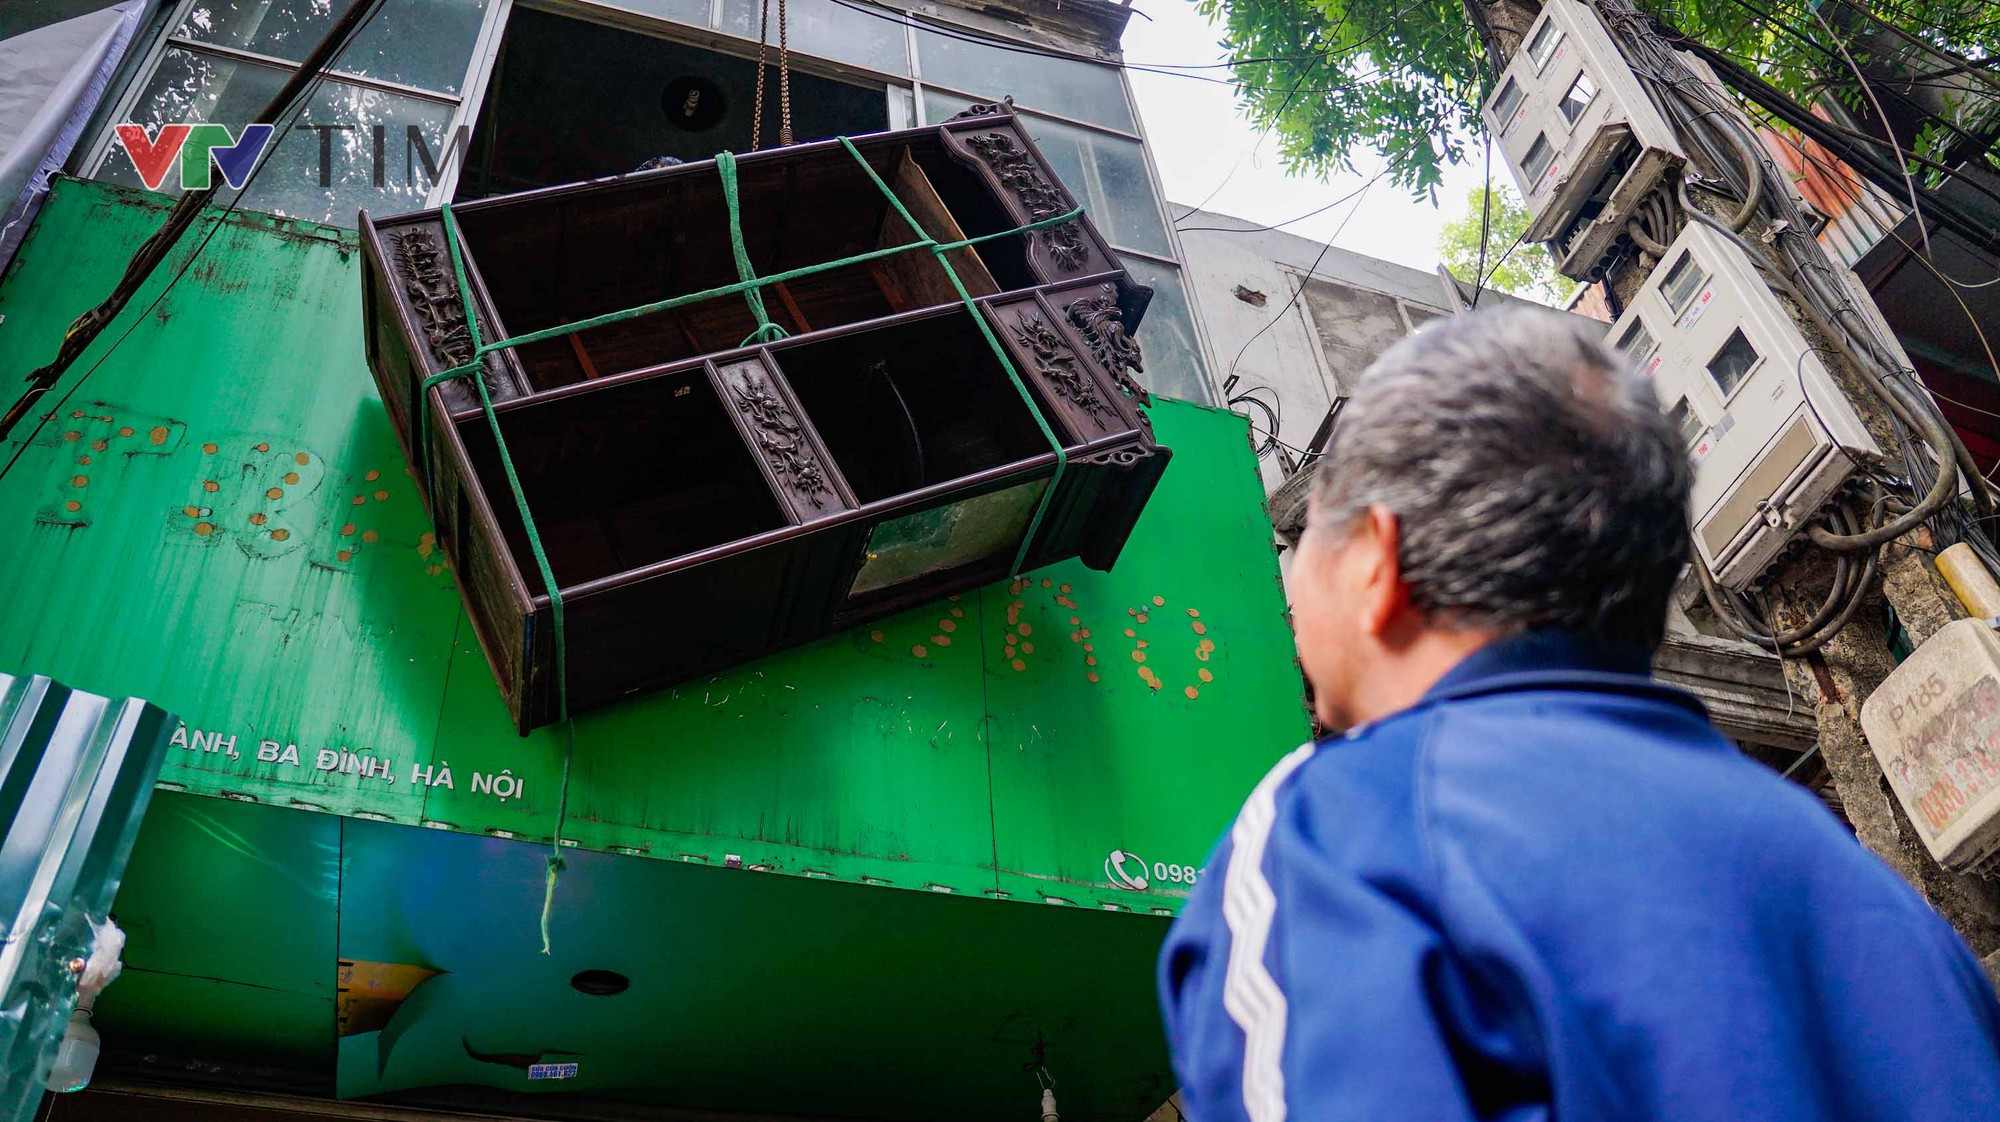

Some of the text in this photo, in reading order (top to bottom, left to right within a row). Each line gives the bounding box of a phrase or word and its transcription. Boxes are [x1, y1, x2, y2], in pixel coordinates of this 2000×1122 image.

[1889, 672, 1946, 731] P185
[257, 740, 300, 766] BA
[316, 746, 395, 785] ĐÌNH,
[411, 760, 455, 789] HÀ
[471, 769, 524, 802] NỘI
